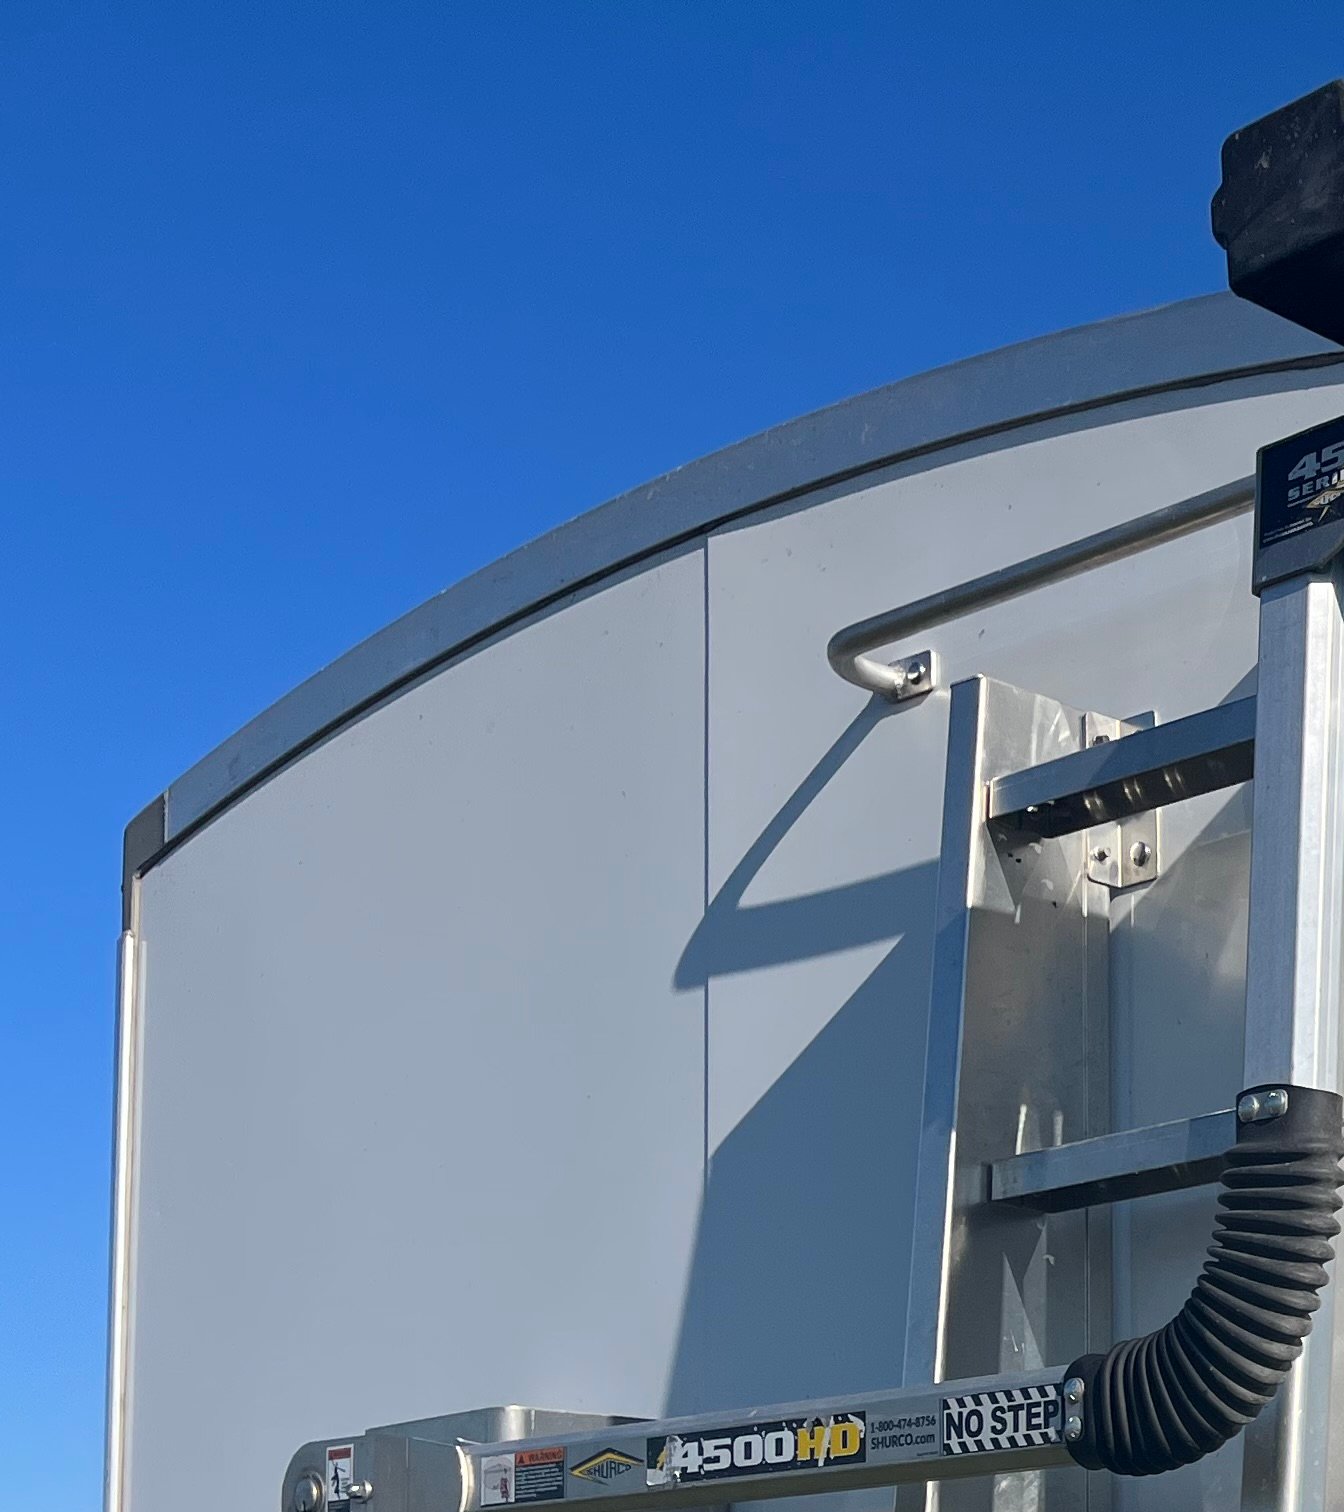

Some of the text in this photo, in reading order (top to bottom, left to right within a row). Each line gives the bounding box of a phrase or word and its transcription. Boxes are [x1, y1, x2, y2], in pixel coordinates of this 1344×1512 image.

[870, 1416, 936, 1434] 1-800-474-8756
[946, 1400, 1059, 1441] NO STEP
[870, 1433, 936, 1450] SHURCO.com
[528, 1449, 563, 1464] WARNING
[584, 1459, 632, 1480] SHURCO
